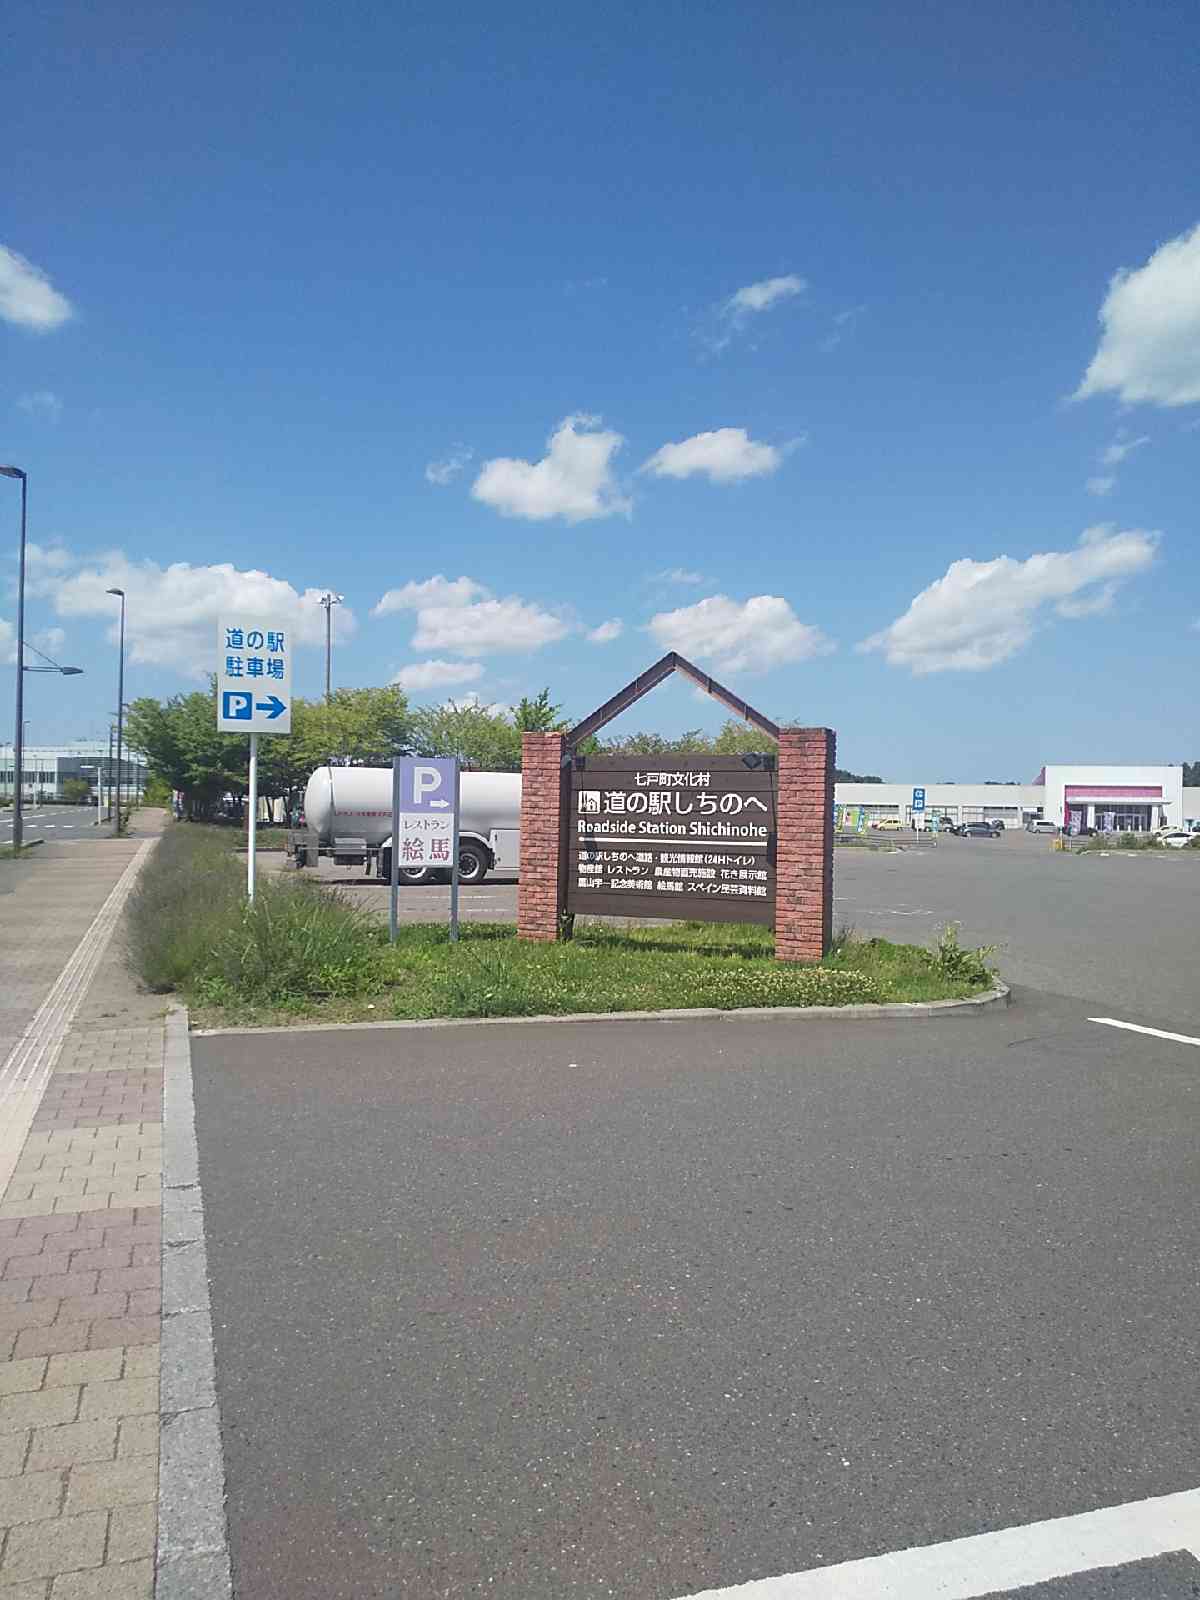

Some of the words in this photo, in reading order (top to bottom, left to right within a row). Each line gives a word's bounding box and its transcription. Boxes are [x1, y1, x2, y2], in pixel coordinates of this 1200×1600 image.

[226, 628, 284, 652] 道の駅
[225, 656, 284, 679] 駐車場
[229, 696, 247, 716] P
[414, 767, 441, 803] P
[634, 772, 710, 787] 七戸町文化村
[604, 791, 768, 814] 道の駅しちのへ
[404, 820, 448, 830] レストラン
[577, 820, 636, 834] Roadside
[639, 821, 686, 835] Station
[689, 821, 768, 837] Shichinohe
[402, 837, 449, 861] 絵馬
[607, 865, 648, 875] レストラン
